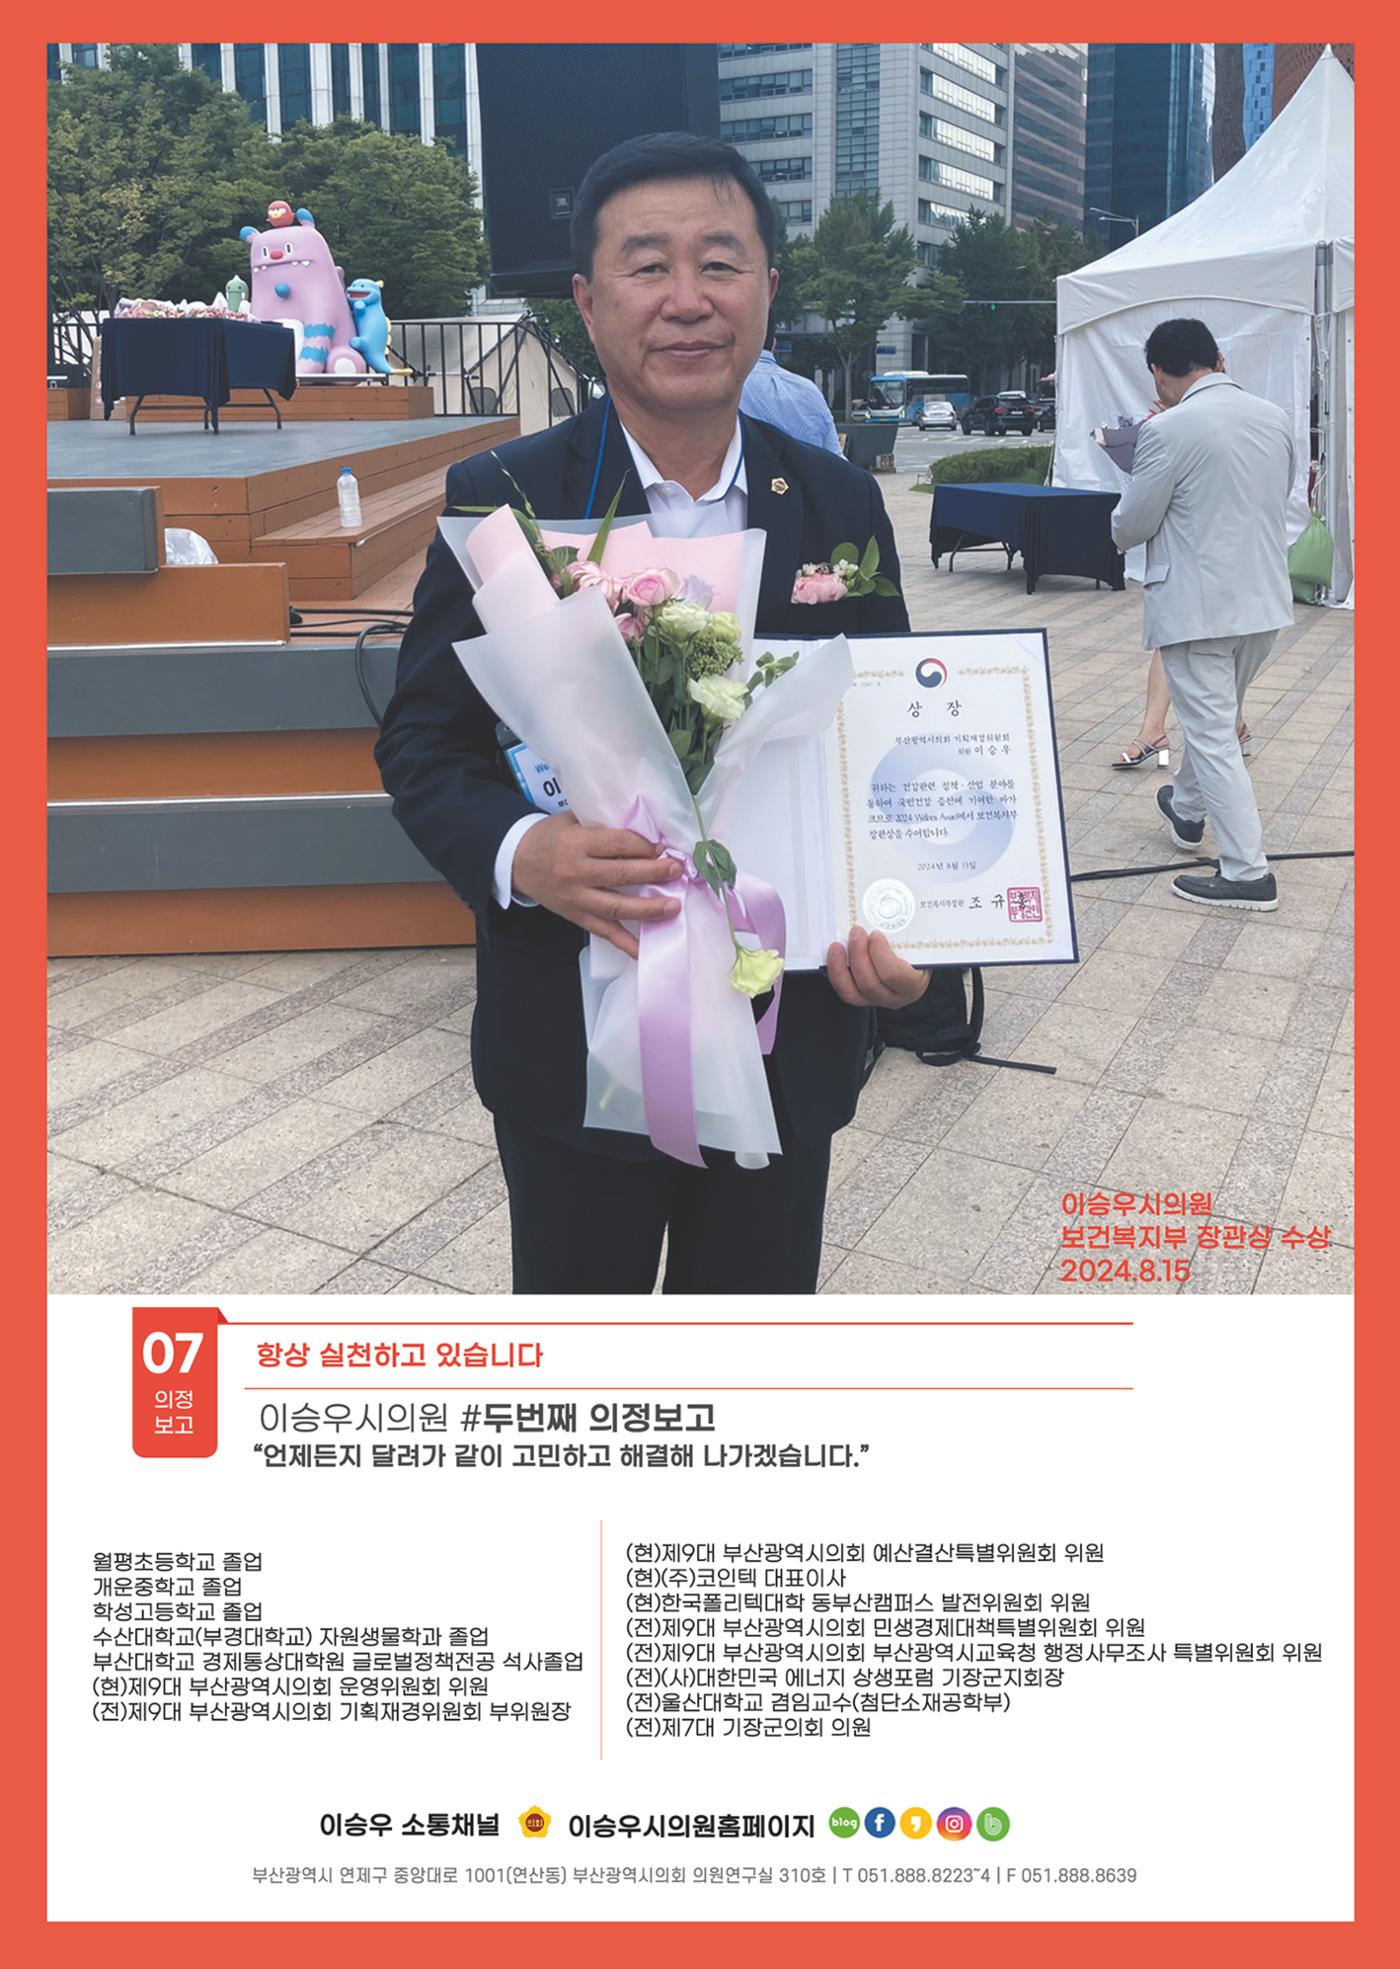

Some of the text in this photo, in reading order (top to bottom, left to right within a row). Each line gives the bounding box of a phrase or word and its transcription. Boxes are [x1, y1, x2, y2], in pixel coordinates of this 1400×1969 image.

[906, 699, 963, 719] 상 장
[895, 735, 951, 745] 부산광역시의회
[968, 896, 983, 909] 조
[991, 893, 1005, 909] 규
